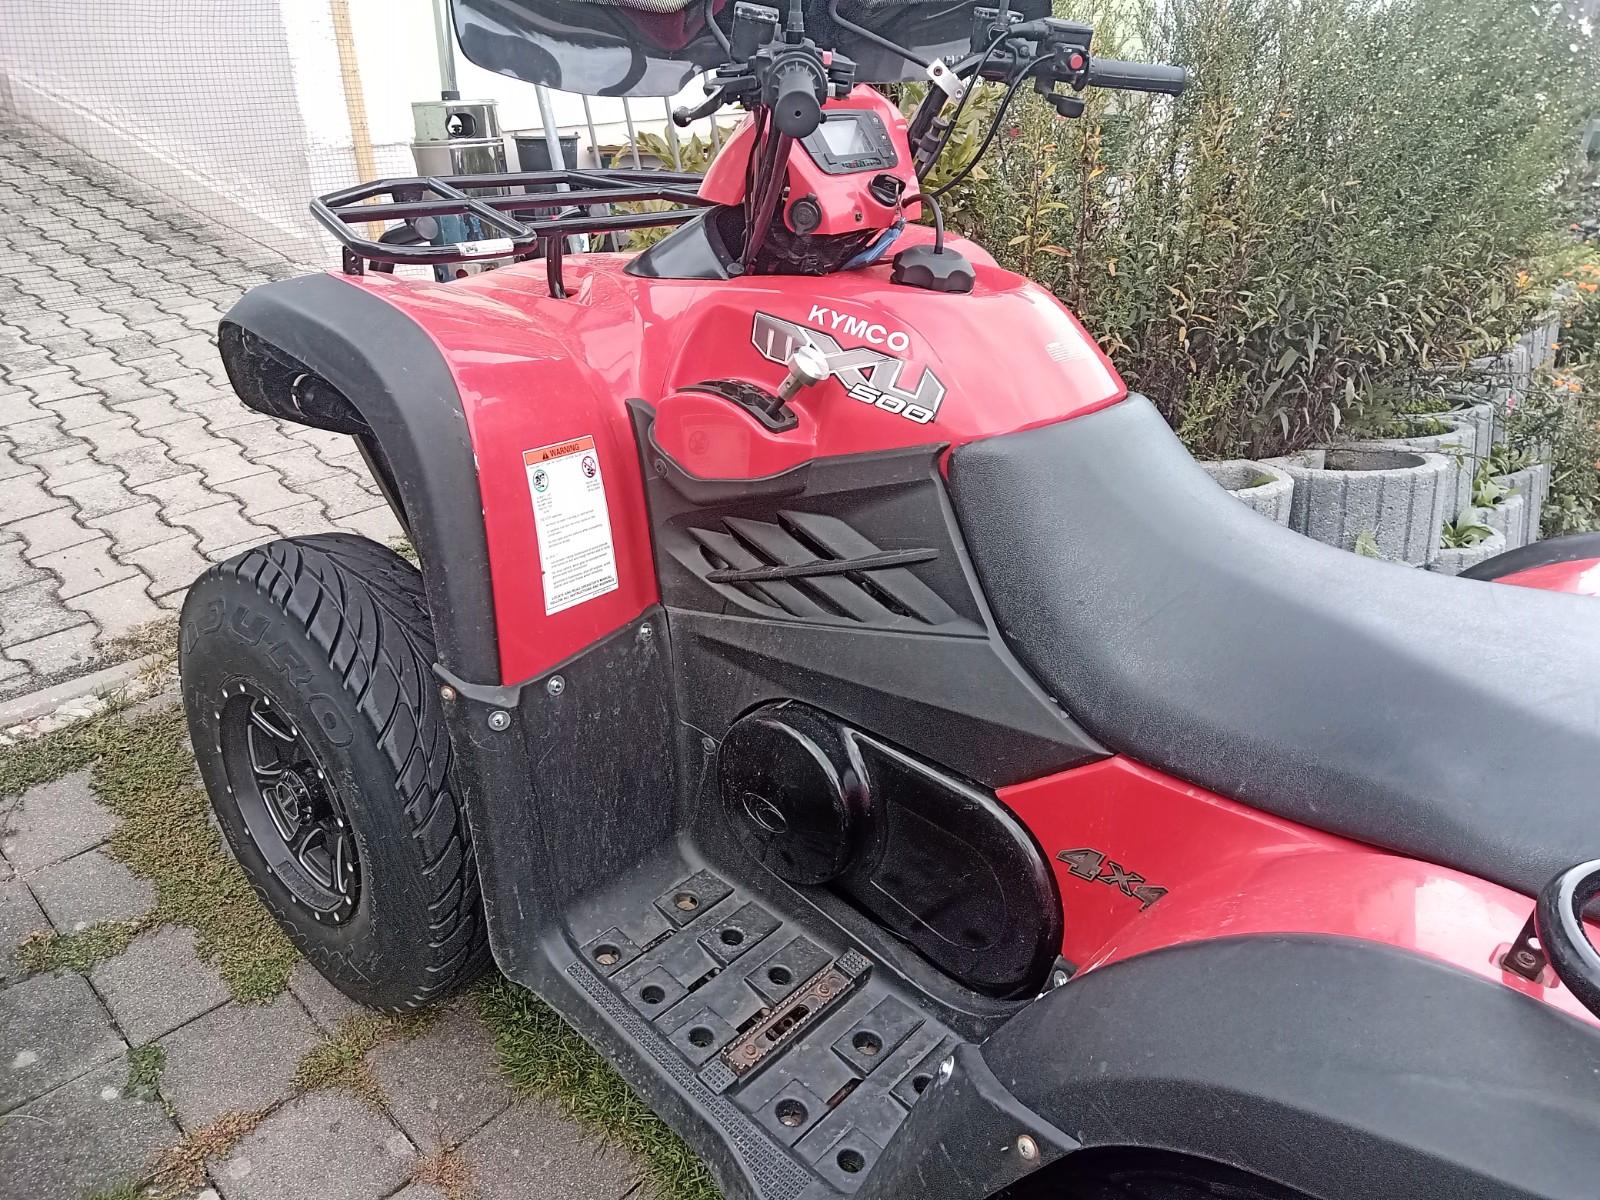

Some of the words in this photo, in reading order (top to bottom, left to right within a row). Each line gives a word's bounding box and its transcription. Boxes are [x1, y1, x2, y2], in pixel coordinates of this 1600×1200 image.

[808, 304, 910, 352] KYMCO
[848, 383, 935, 424] 500
[549, 443, 580, 457] WARNING
